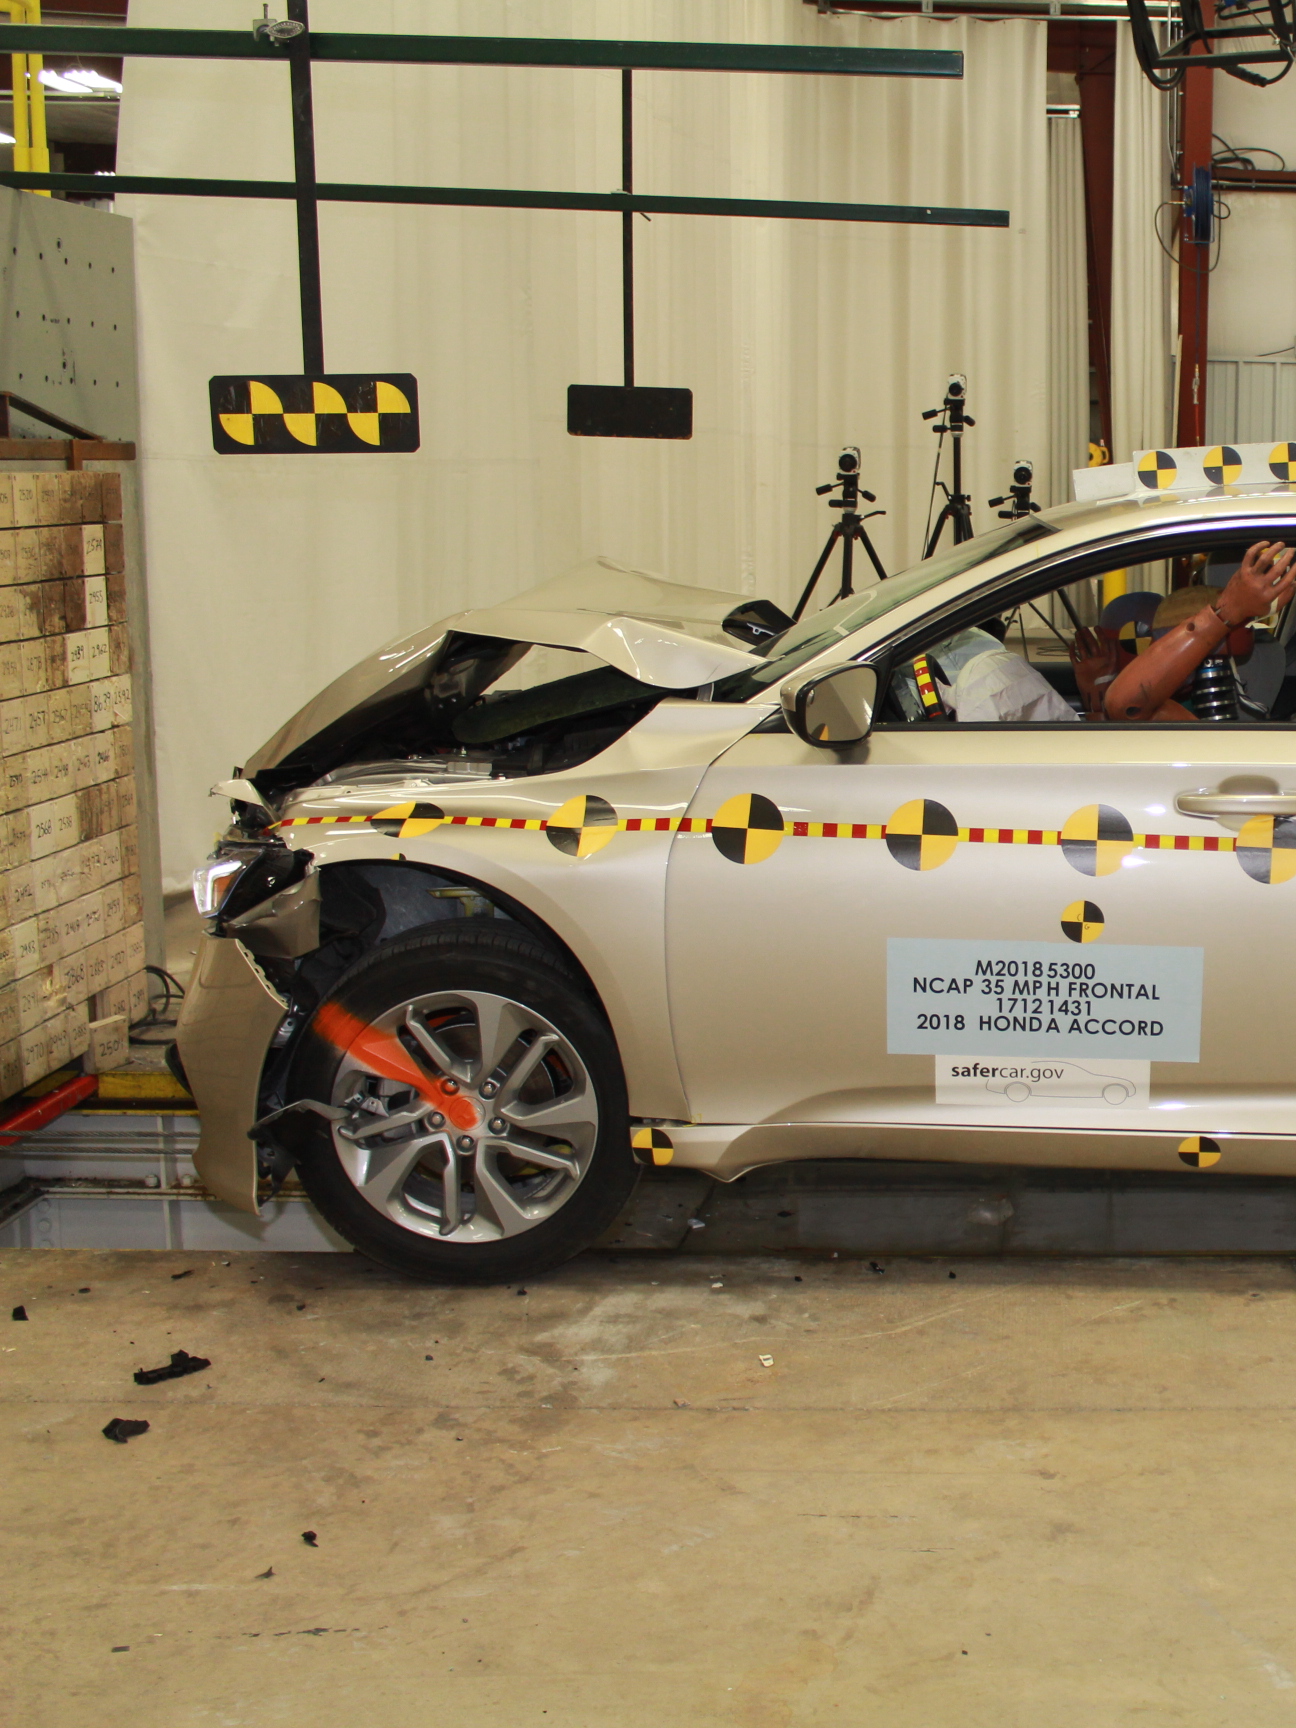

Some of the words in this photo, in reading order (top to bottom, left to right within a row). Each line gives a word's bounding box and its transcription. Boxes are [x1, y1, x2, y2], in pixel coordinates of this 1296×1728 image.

[975, 960, 1096, 980] M20185300
[913, 977, 974, 995] NCAP
[980, 979, 1005, 996] 35
[1011, 980, 1060, 997] MPH
[1068, 982, 1160, 1001] FRONTAL
[996, 998, 1092, 1017] 17121431
[916, 1014, 966, 1031] 2018
[979, 1015, 1061, 1034] HONDA
[1068, 1018, 1164, 1037] ACCORD
[951, 1062, 1065, 1082] safercar.gov
